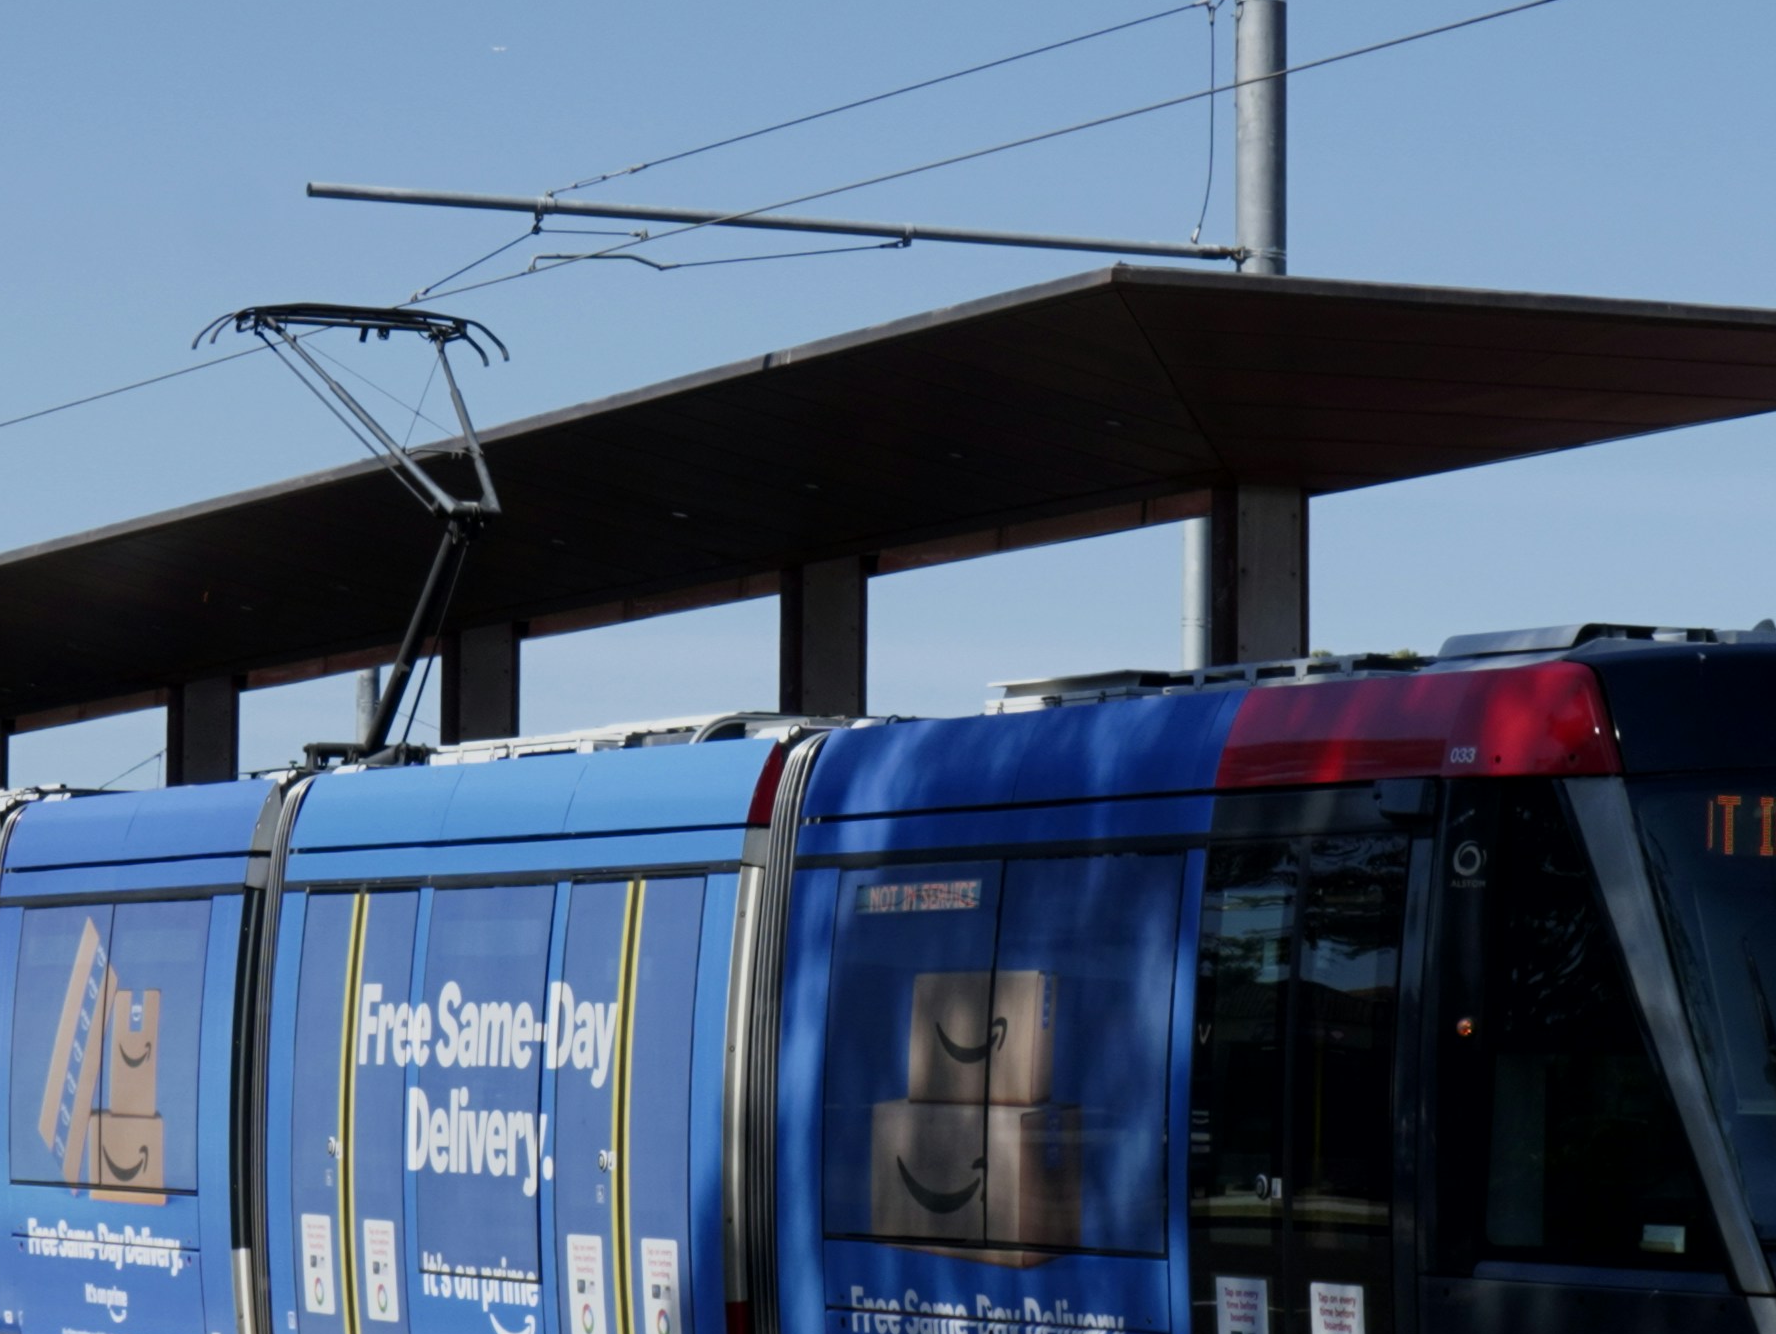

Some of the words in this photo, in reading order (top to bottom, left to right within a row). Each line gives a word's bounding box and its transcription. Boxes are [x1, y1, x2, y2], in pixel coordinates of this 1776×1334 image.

[1450, 747, 1476, 763] 033
[1707, 794, 1742, 855] T
[869, 885, 898, 911] NOT
[902, 884, 915, 911] IN
[919, 880, 977, 909] SERVICE
[1451, 879, 1486, 888] ALSTOM
[358, 983, 432, 1067] Free
[435, 980, 619, 1089] Same-Day
[407, 1085, 554, 1197] Delivery.
[28, 1217, 57, 1257] Free
[57, 1219, 124, 1270] Same-Day
[124, 1225, 184, 1277] Delivery.
[423, 1251, 452, 1298] It's
[453, 1265, 479, 1301] on
[481, 1256, 539, 1312] prime
